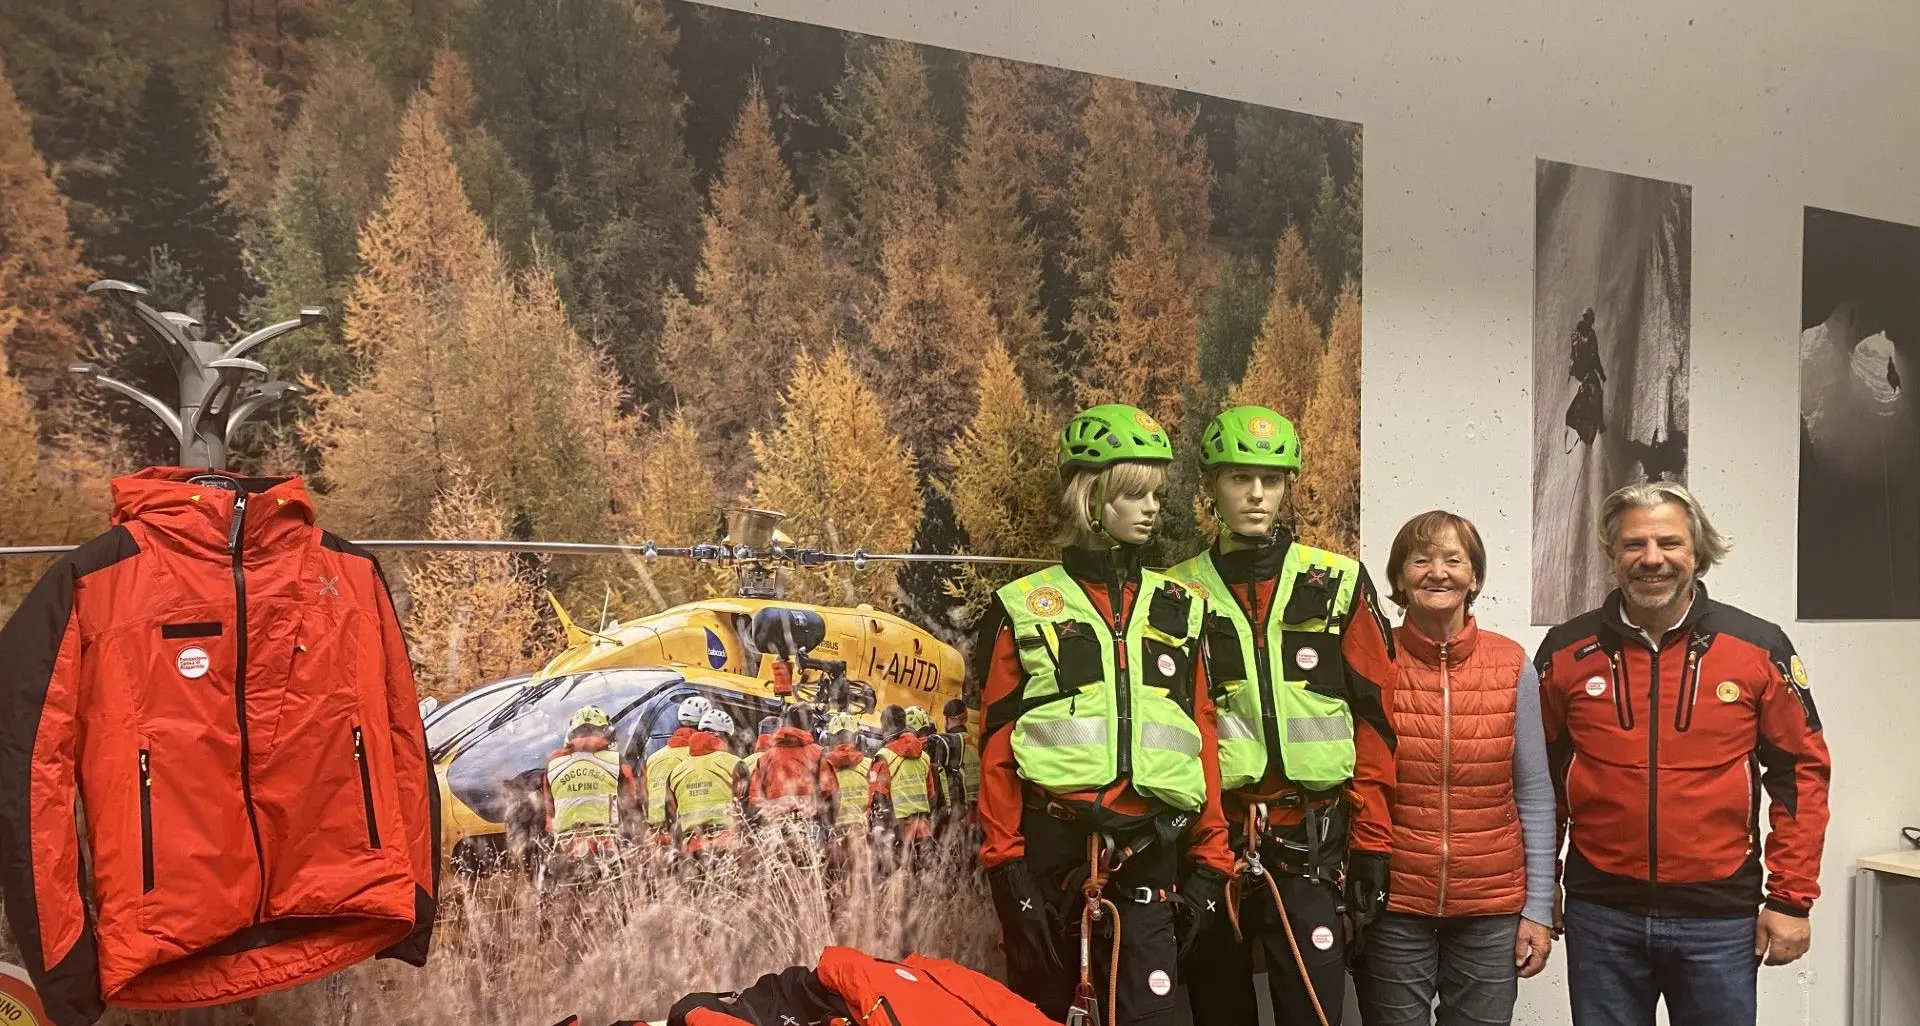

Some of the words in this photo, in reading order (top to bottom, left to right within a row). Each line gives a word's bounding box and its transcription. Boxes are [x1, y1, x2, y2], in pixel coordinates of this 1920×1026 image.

[868, 646, 939, 692] I-AHTD
[560, 768, 606, 786] SOCCORSO
[567, 781, 599, 792] ALPINO
[0, 998, 22, 1021] INO
